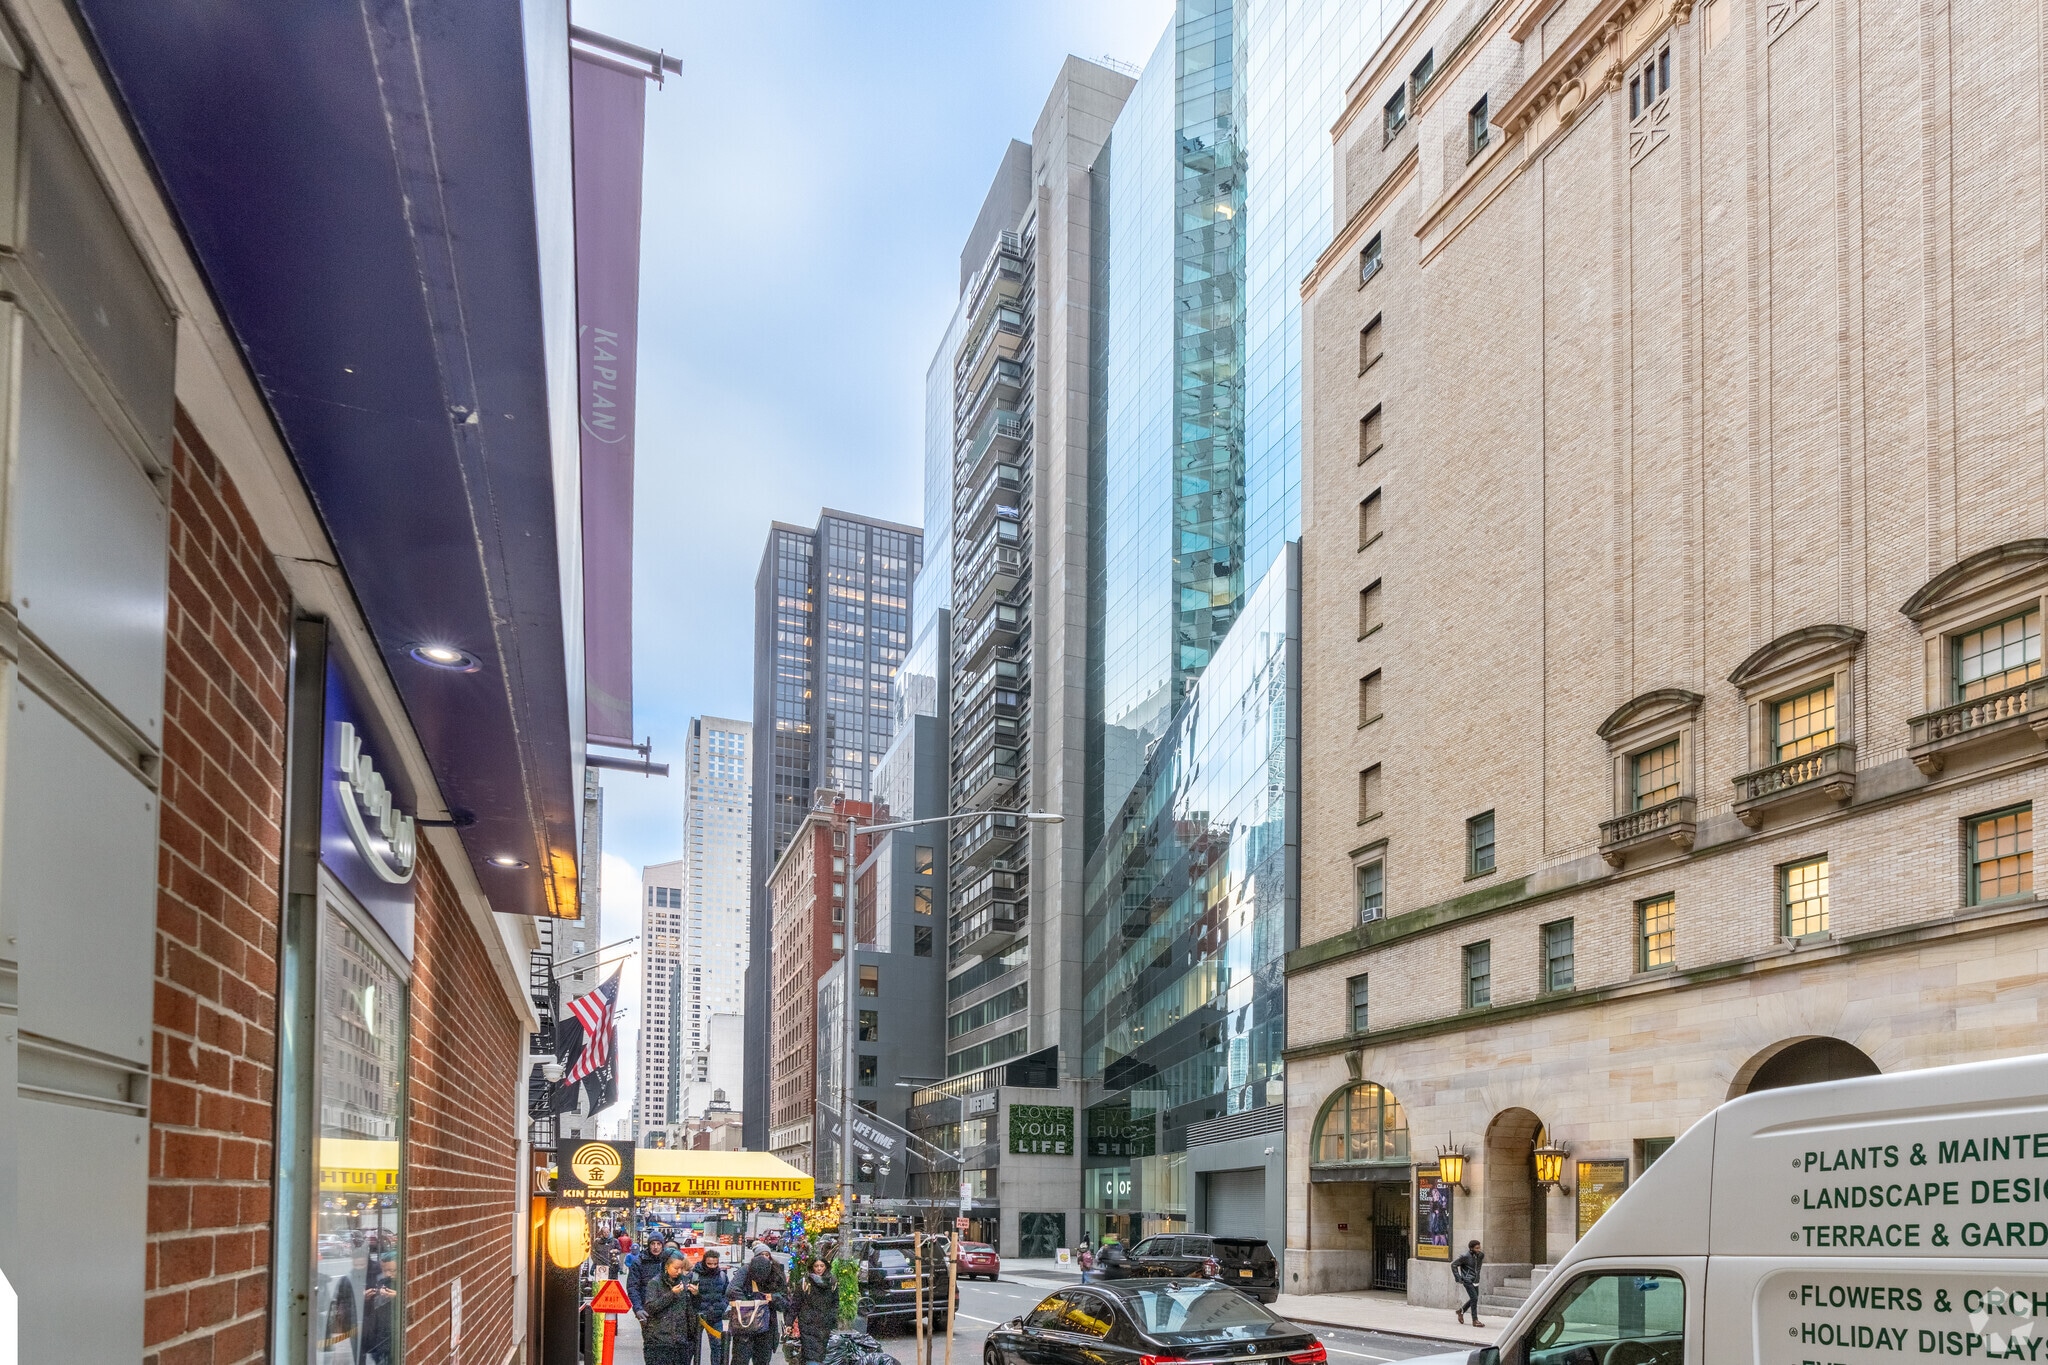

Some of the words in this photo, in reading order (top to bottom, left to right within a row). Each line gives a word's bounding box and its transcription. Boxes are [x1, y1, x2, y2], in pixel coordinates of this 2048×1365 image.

[592, 327, 618, 430] KAPLAN
[1018, 1105, 1066, 1120] LOVE
[853, 1118, 872, 1139] LIFE
[870, 1127, 897, 1150] TIME
[1018, 1122, 1066, 1136] YOUR
[1018, 1140, 1066, 1154] LIFE
[1804, 1145, 1899, 1173] PLANTS
[1909, 1143, 1927, 1166] &
[1939, 1133, 2048, 1164] MAINTE
[589, 1167, 605, 1181] 金
[563, 1189, 585, 1198] KIN
[587, 1190, 629, 1199] RAMEN
[635, 1178, 681, 1196] Topaz
[687, 1179, 720, 1190] THAI
[725, 1180, 802, 1192] AUTHENTIC
[1803, 1181, 1959, 1210] LANDSCAPE
[1971, 1177, 2048, 1204] DESI
[1803, 1223, 1920, 1247] TERRACE
[1931, 1223, 1950, 1247] &
[1961, 1222, 2048, 1247] GARD
[1801, 1285, 1922, 1312] FLOWERS
[1933, 1289, 1952, 1313] &
[1801, 1322, 1909, 1352] HOLIDAY
[1918, 1329, 2048, 1362] DISPLAY
